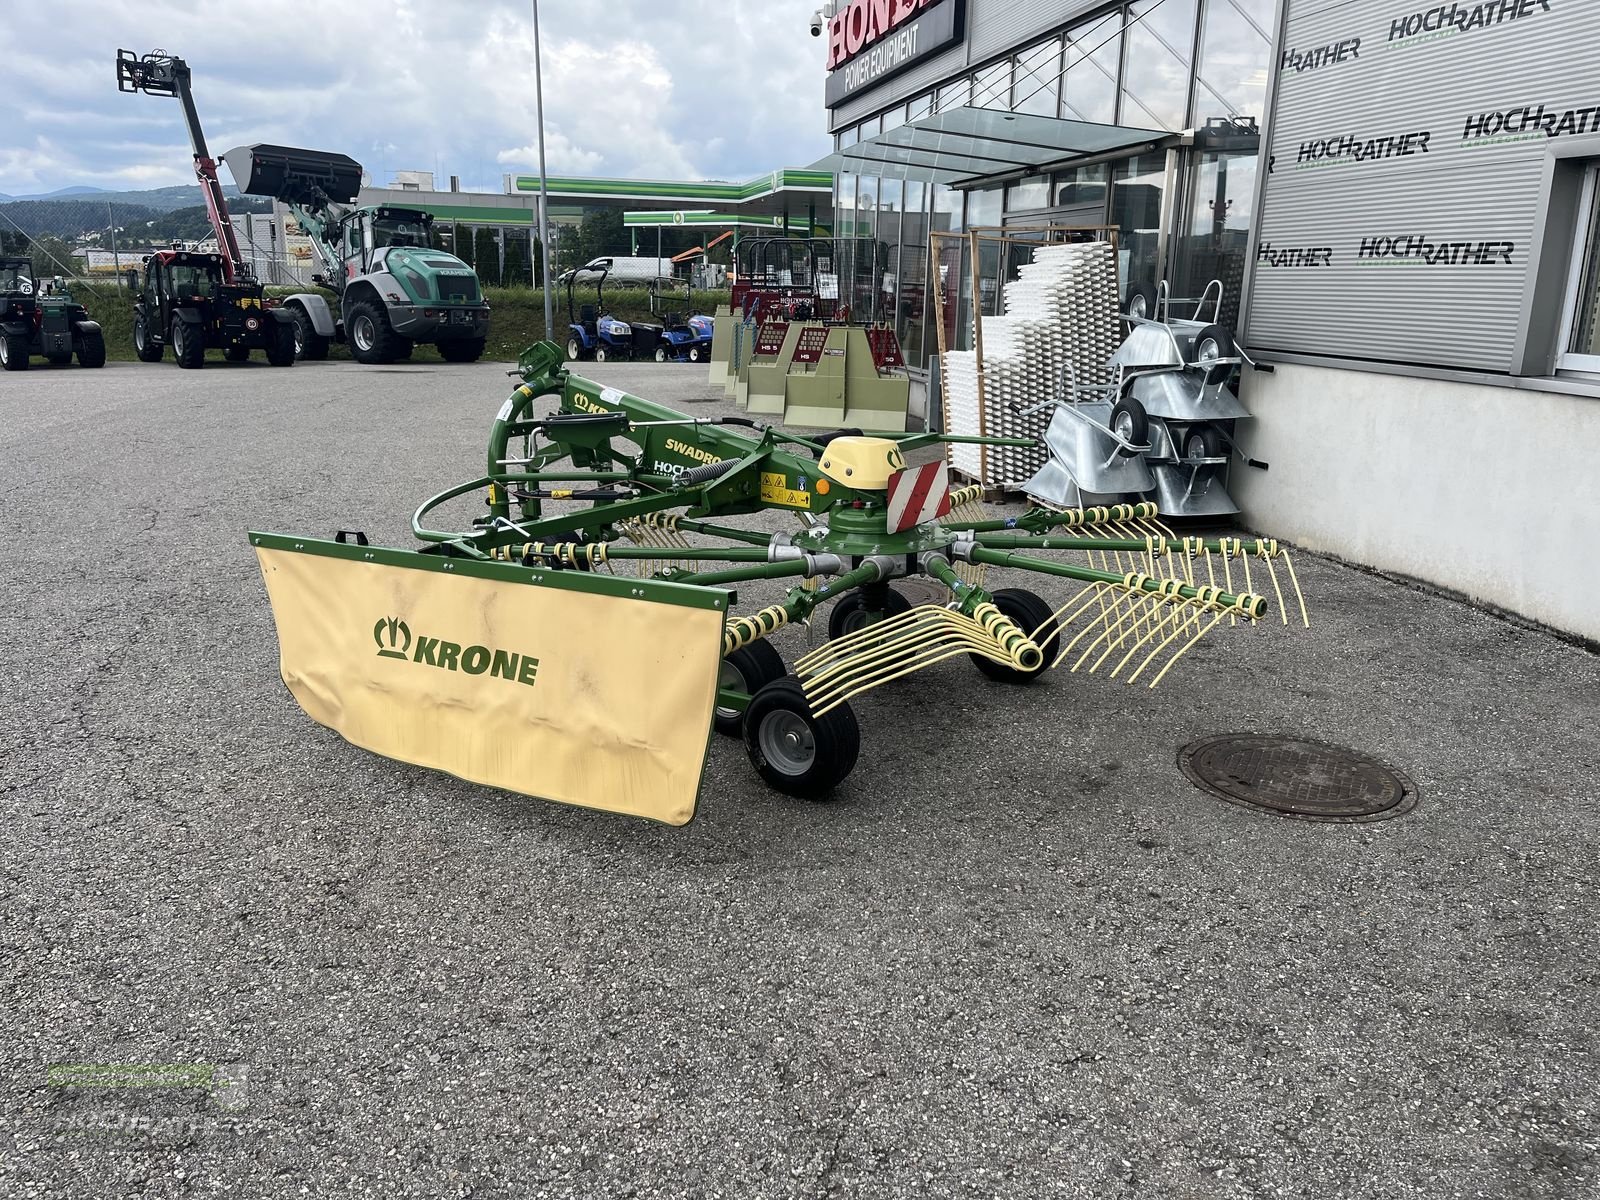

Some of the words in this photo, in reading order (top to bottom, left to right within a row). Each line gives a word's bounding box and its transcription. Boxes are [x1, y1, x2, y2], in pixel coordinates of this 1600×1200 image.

[826, 0, 932, 71] HOND
[845, 59, 869, 93] POWER
[870, 24, 919, 78] EQUIPMENT
[1297, 131, 1431, 163] HOCHRATHER
[1358, 235, 1515, 265] HOCHRATHER
[22, 284, 31, 293] 25
[413, 636, 540, 687] KRONE
